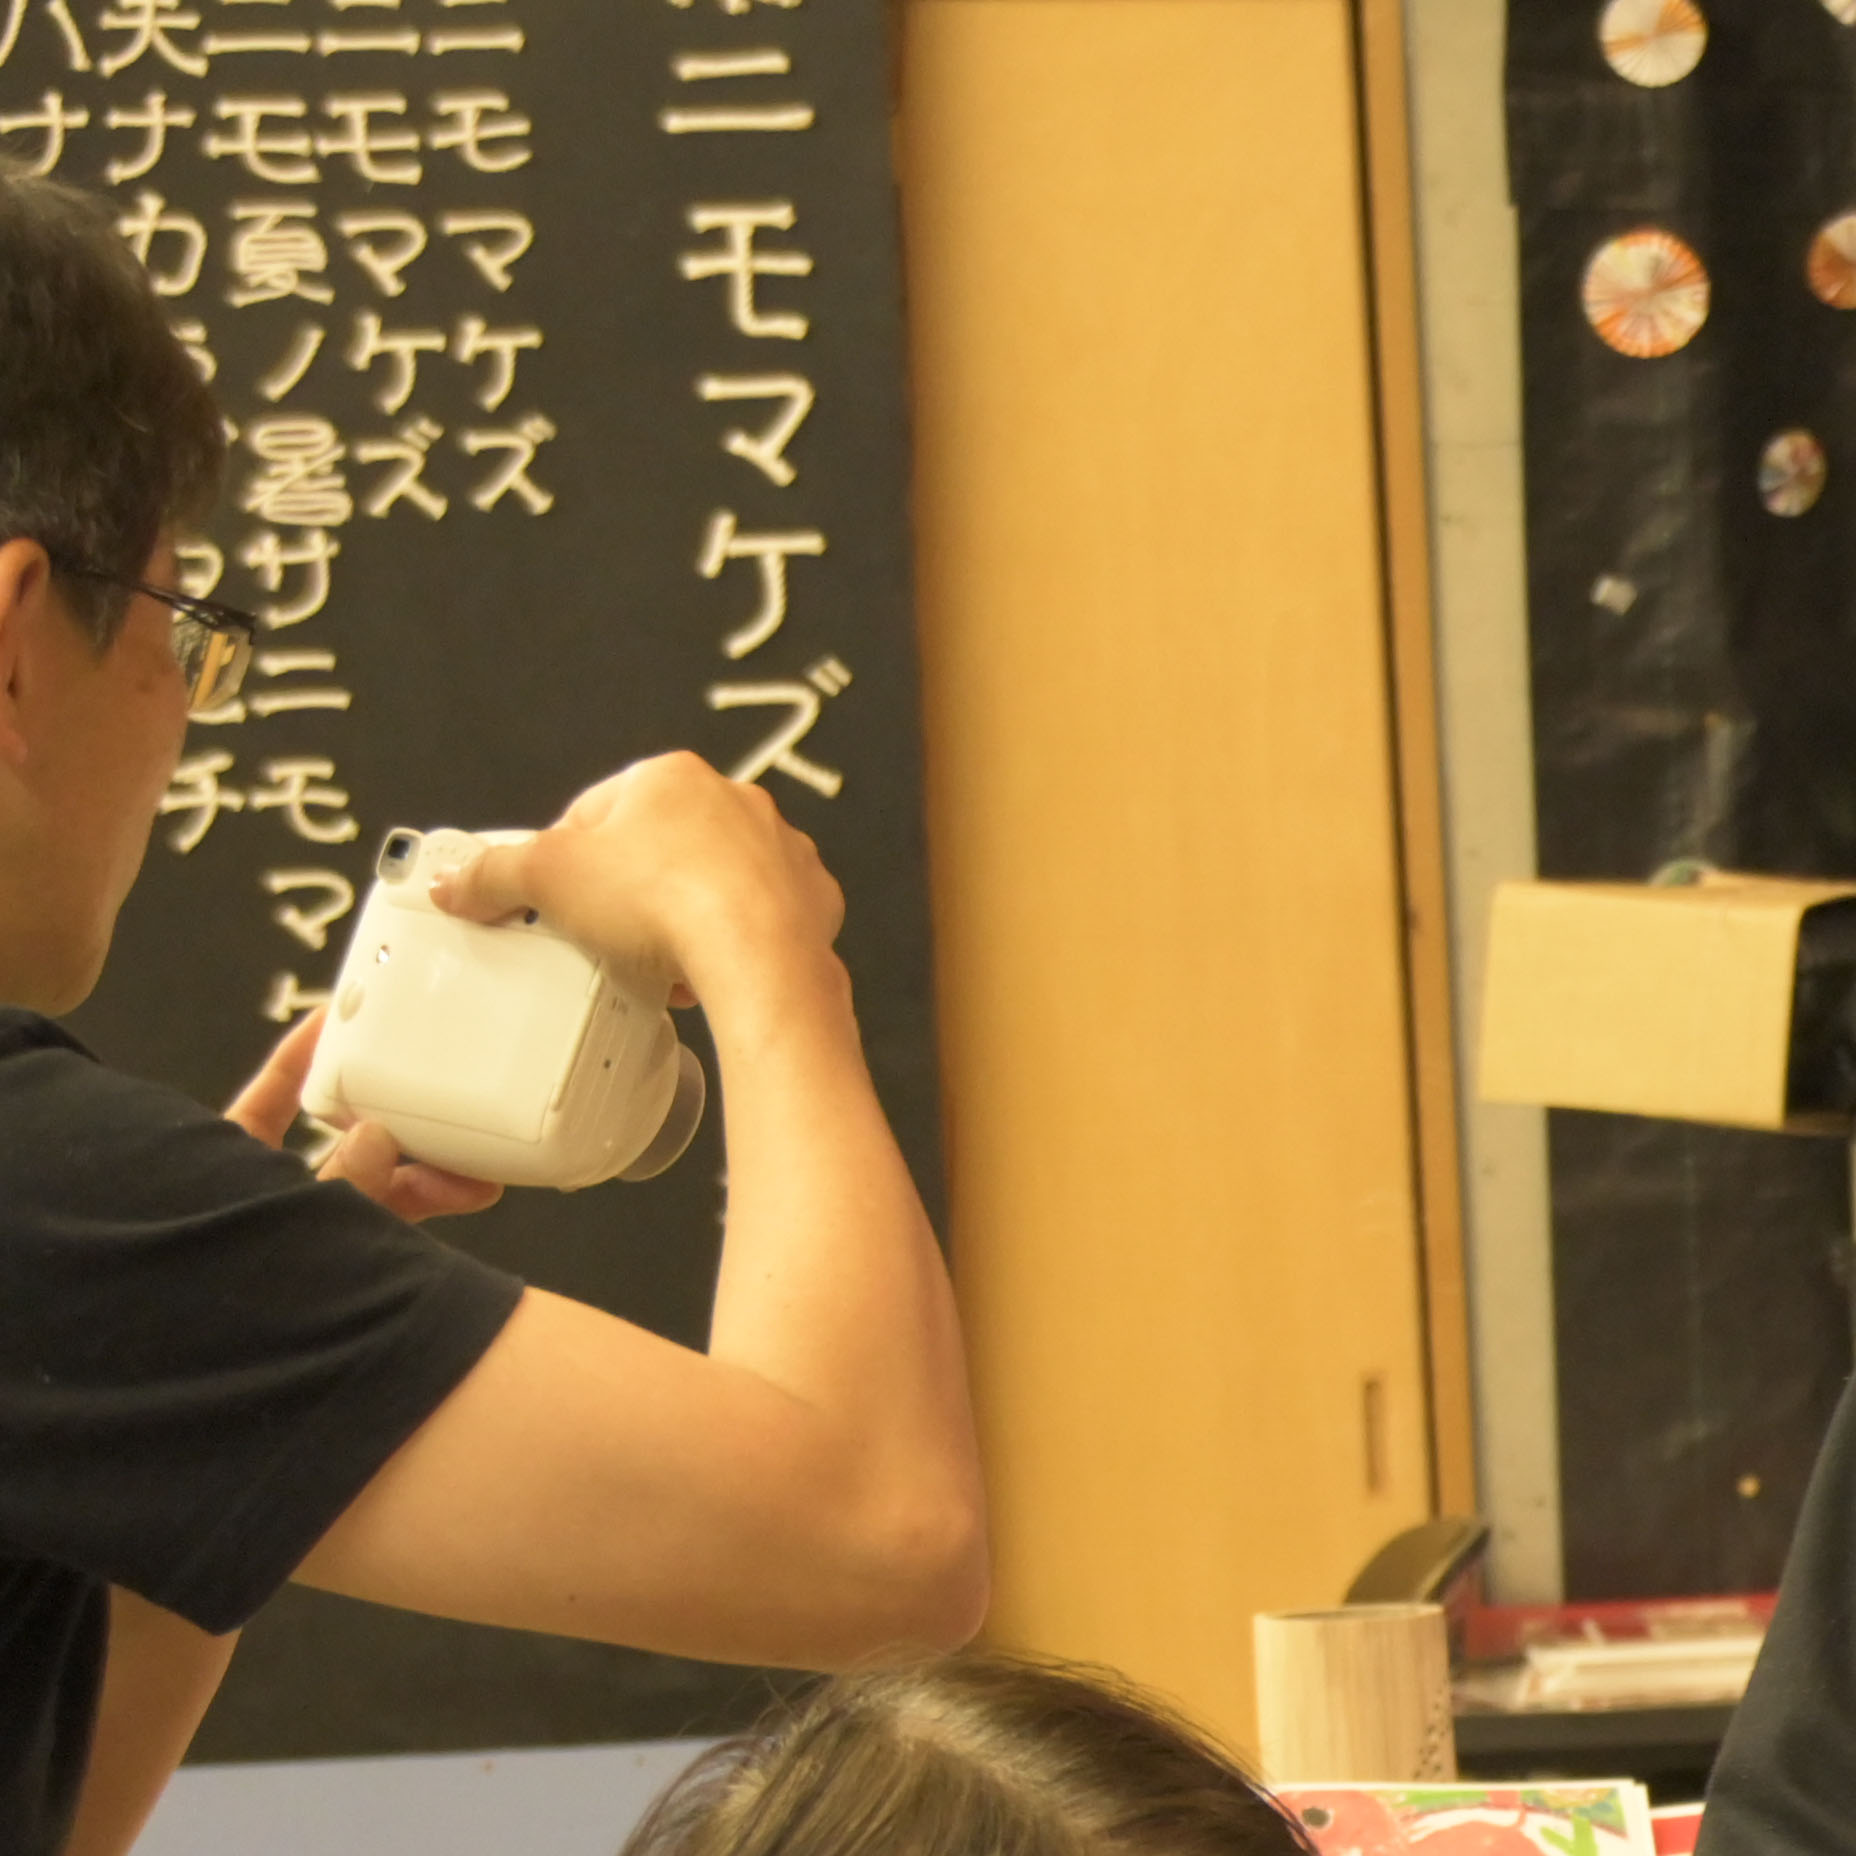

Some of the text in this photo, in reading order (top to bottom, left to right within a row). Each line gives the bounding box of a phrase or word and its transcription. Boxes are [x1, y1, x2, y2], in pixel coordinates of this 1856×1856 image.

[315, 0, 449, 520] ニモマケズ
[427, 0, 557, 515] ニモマケズ
[658, 0, 853, 799] ニモマケズ
